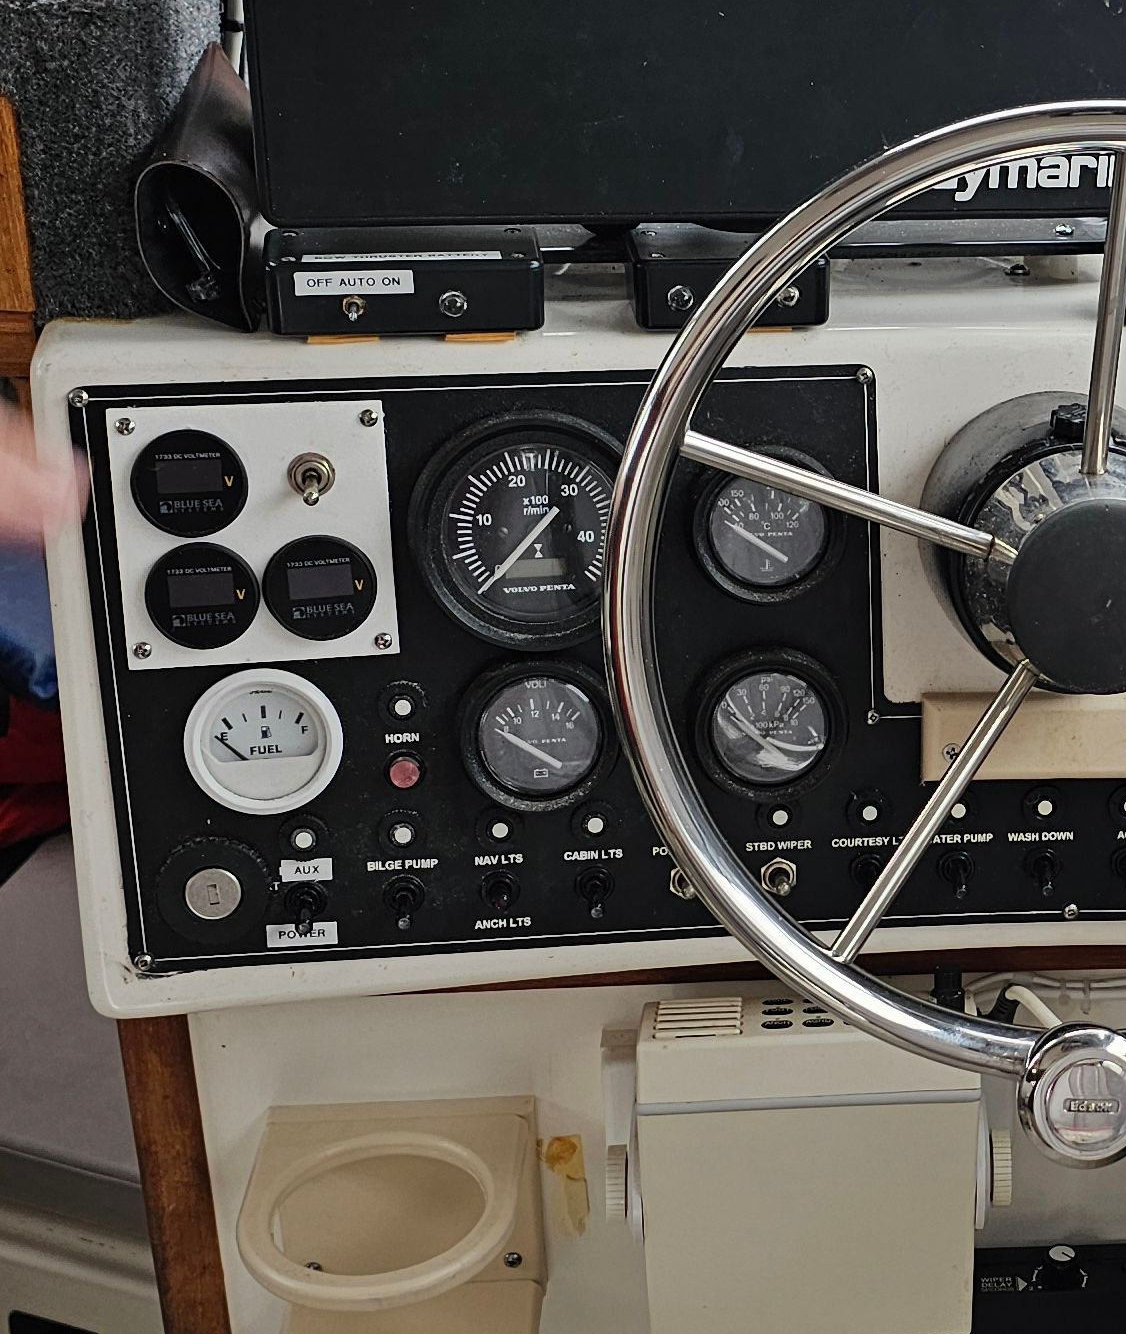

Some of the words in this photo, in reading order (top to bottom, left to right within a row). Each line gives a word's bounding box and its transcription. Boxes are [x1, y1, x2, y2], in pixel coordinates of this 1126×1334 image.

[306, 278, 333, 288] OFF
[339, 277, 376, 287] AUTO
[382, 276, 401, 286] ON
[224, 475, 234, 487] V
[508, 475, 525, 487] 20
[561, 484, 578, 496] 30
[730, 489, 744, 498] 150
[173, 499, 201, 508] BLUE
[202, 498, 223, 507] SEA
[522, 495, 549, 505] x100
[523, 505, 549, 515] r/min
[476, 514, 492, 526] 10
[749, 512, 759, 521] 80
[771, 512, 784, 520] 100
[786, 521, 799, 529] 120
[577, 530, 594, 542] 40
[315, 558, 351, 566] VOLTMETER
[354, 579, 364, 590] V
[503, 585, 538, 594] VOLVO
[539, 583, 576, 591] PENTA
[236, 588, 246, 600] V
[305, 605, 333, 613] BLUE
[334, 603, 354, 611] SEA
[186, 613, 214, 622] BLUE
[215, 612, 235, 621] SEA
[513, 717, 522, 725] 10
[301, 725, 309, 734] F
[220, 732, 229, 741] E
[385, 733, 420, 743] HORN
[250, 744, 283, 755] FUEL
[831, 836, 890, 848] COURTESY
[932, 833, 962, 844] ATER
[963, 833, 994, 843] PUMP
[1008, 832, 1040, 842] WASH
[1041, 831, 1074, 841] DOWN
[745, 841, 775, 852] STBD
[777, 839, 812, 850] WIPER
[475, 854, 499, 866] NAV
[501, 853, 524, 865] LTS
[564, 849, 598, 861] CABIN
[601, 848, 623, 860] LTS
[294, 865, 320, 875] AUX
[367, 860, 403, 872] BILGE
[404, 858, 439, 870] PUMP
[474, 919, 507, 930] ANCH
[509, 917, 531, 928] LTS
